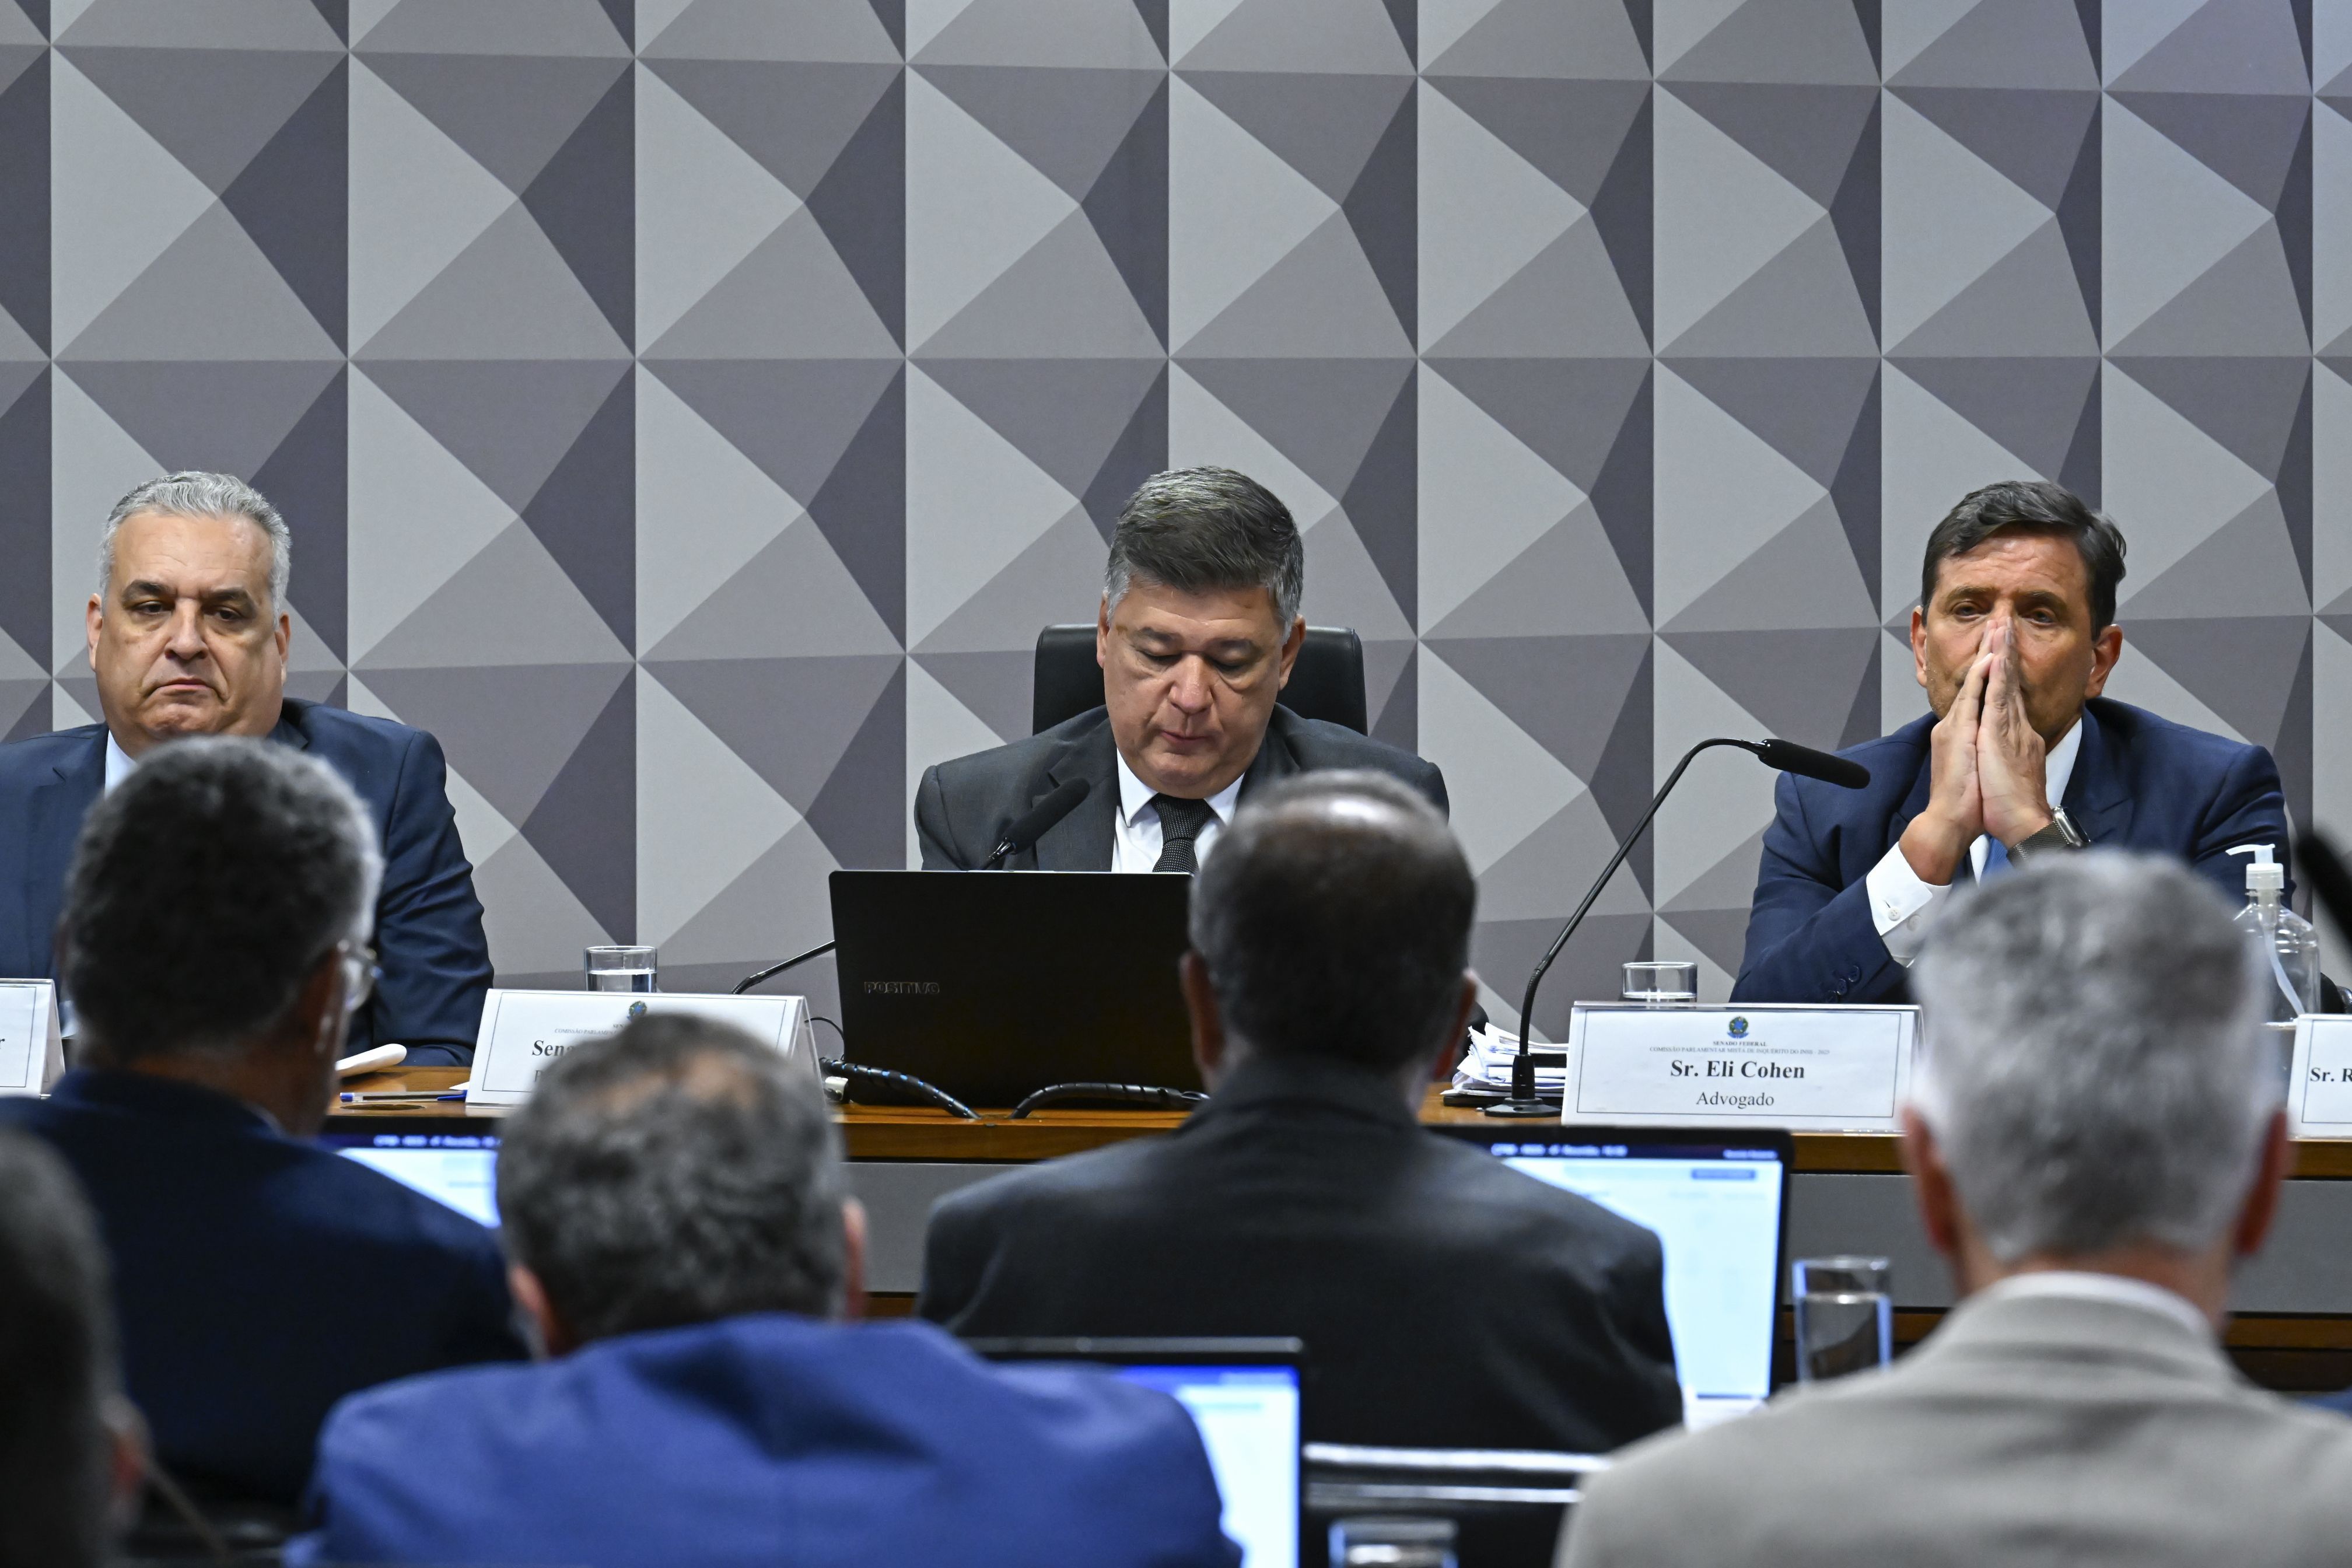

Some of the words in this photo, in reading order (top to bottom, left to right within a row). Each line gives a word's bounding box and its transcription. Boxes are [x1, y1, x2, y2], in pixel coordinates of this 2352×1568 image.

[1671, 1060, 1698, 1077] Sr.
[1707, 1060, 1734, 1077] Eli
[1741, 1061, 1804, 1078] Cohen
[2310, 1068, 2334, 1082] Sr.
[1696, 1092, 1774, 1109] Advogado
